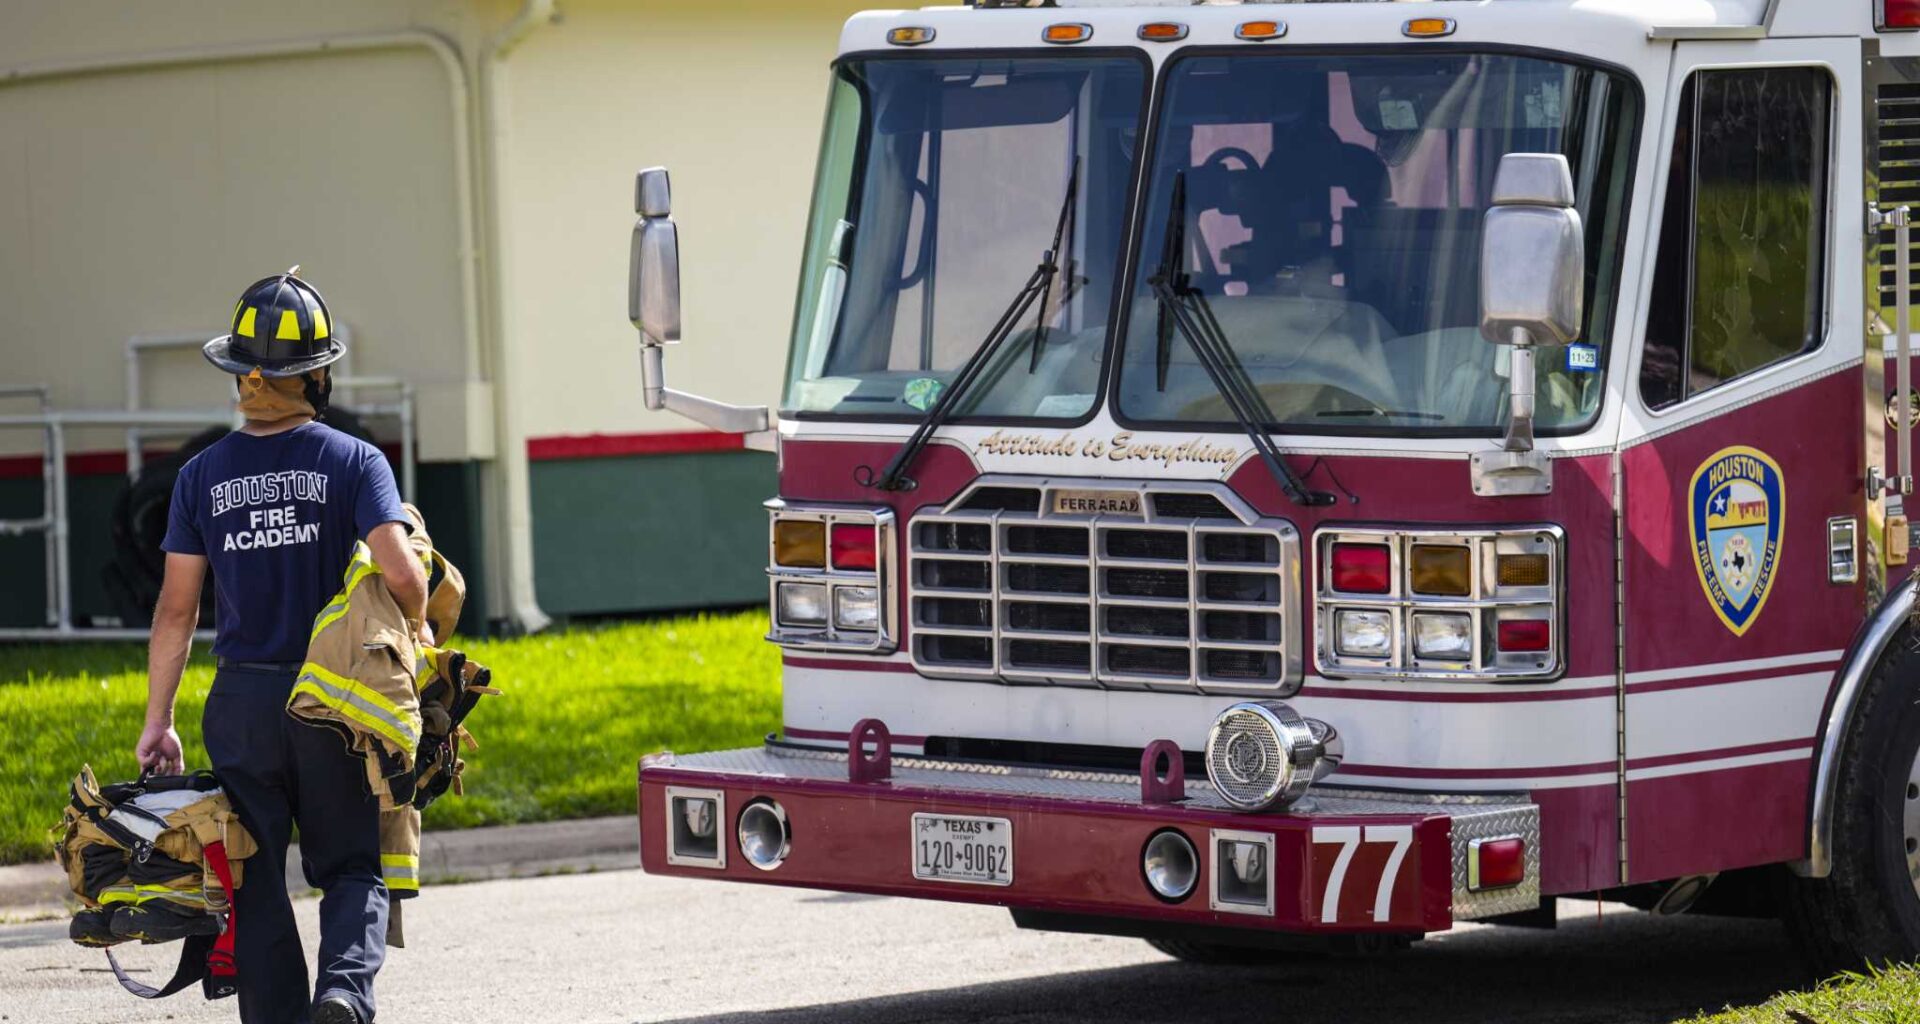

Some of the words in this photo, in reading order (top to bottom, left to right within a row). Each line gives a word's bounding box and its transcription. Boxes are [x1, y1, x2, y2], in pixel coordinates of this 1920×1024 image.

[972, 429, 1077, 457] Attitude
[1082, 437, 1104, 458] is
[1108, 431, 1238, 472] Everything
[210, 469, 328, 517] HOUSTON
[1708, 455, 1765, 490] HOUSTON
[223, 522, 321, 552] ACADEMY
[249, 505, 297, 530] FIRE
[1698, 540, 1727, 608] FIRE-EMS
[1753, 539, 1776, 600] RESCUE
[943, 819, 982, 834] TEXAS
[1312, 825, 1413, 923] 77
